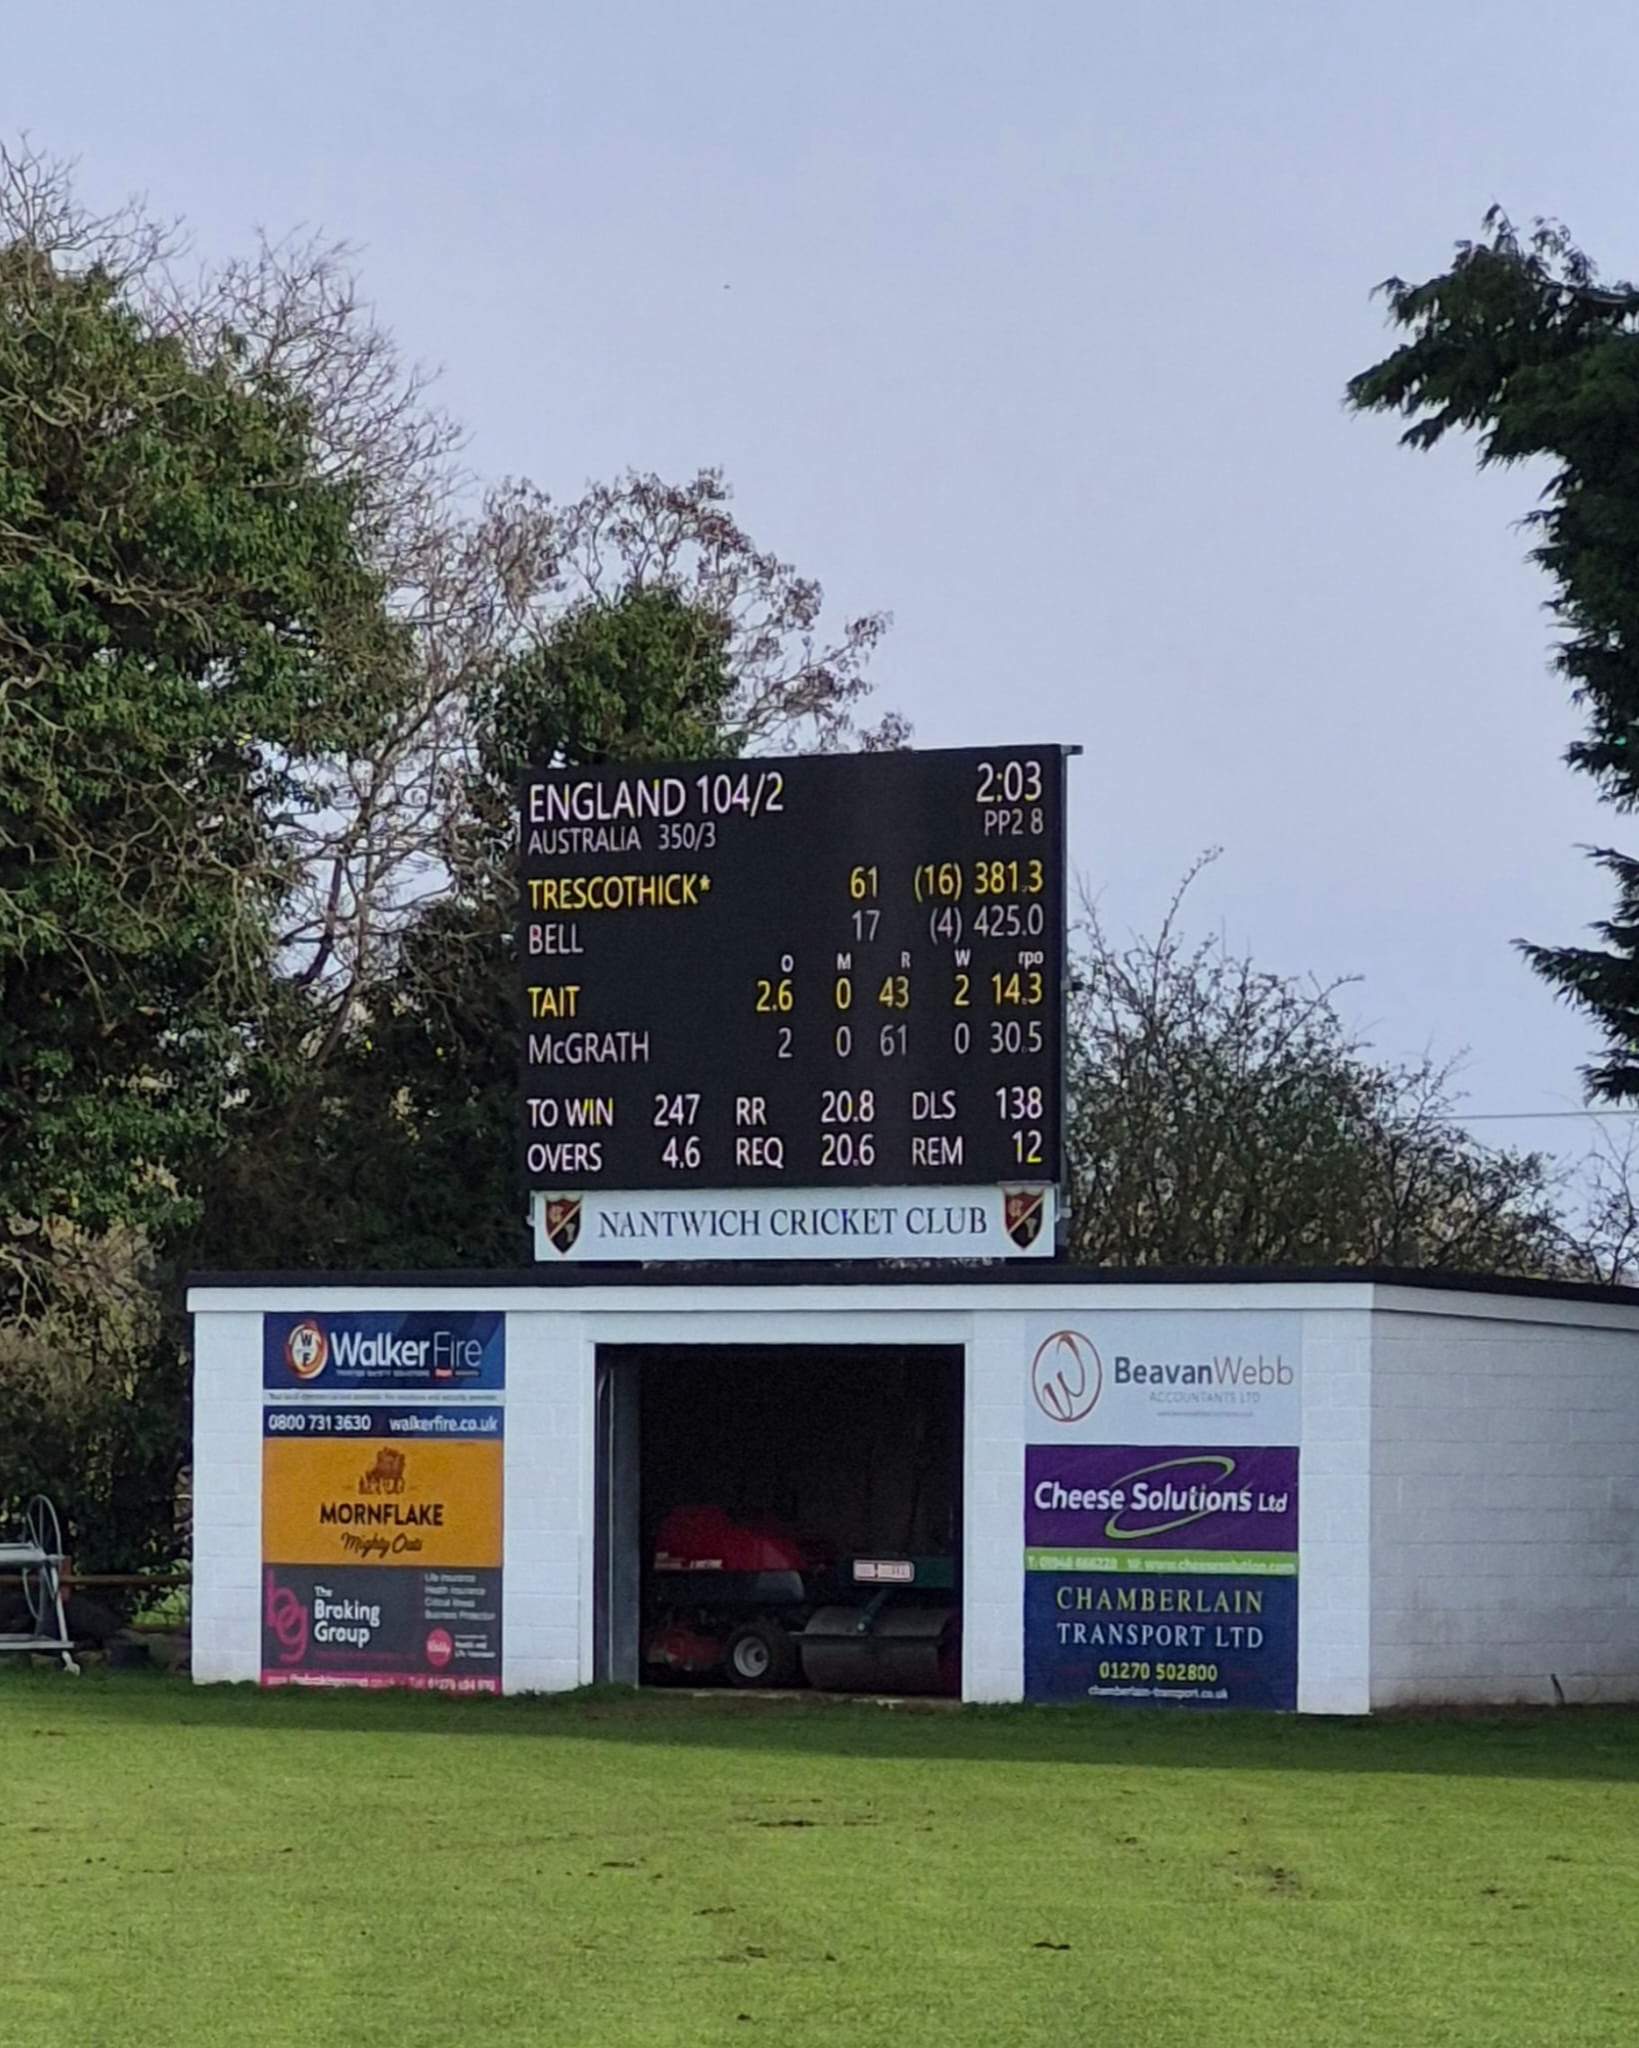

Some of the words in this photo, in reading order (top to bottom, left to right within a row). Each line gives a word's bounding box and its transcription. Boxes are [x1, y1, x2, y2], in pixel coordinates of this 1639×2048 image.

[976, 761, 1042, 803] 2:03
[530, 778, 686, 823] ENGLAND
[696, 771, 784, 817] 104/2
[984, 808, 1024, 836] PP2
[1030, 808, 1044, 835] 8
[528, 825, 642, 855] AUSTRALIA
[658, 821, 717, 851] 350/3
[850, 866, 878, 899] 61
[914, 863, 963, 903] (16)
[974, 859, 1044, 896] 381.3
[528, 923, 584, 954] BELL
[852, 910, 881, 941] 17
[930, 906, 963, 944] (4)
[973, 903, 1044, 937] 425.0
[836, 952, 852, 971] M
[901, 951, 911, 969] R
[954, 948, 971, 967] W
[1018, 951, 1044, 970] rpo
[527, 985, 581, 1018] TAIT
[755, 978, 793, 1012] 2.6
[836, 977, 851, 1010] 0
[878, 975, 910, 1008] 43
[953, 974, 971, 1007] 2
[991, 971, 1043, 1006] 14.3
[528, 1030, 649, 1065] McGRATH
[778, 1026, 793, 1059] 2
[836, 1025, 851, 1058] 0
[879, 1024, 907, 1056] 61
[953, 1021, 971, 1055] 0
[989, 1020, 1043, 1054] 30.5
[526, 1098, 558, 1128] TO
[564, 1096, 613, 1127] WIN
[653, 1093, 701, 1127] 247
[736, 1096, 767, 1126] RR
[820, 1089, 875, 1123] 20.8
[912, 1089, 956, 1120] DLS
[995, 1086, 1043, 1120] 138
[527, 1142, 602, 1172] OVERS
[661, 1136, 701, 1169] 4.6
[736, 1136, 784, 1169] REQ
[820, 1133, 875, 1167] 20.6
[912, 1136, 963, 1166] REM
[1012, 1129, 1042, 1163] 12
[598, 1209, 760, 1238] NANTWICH
[769, 1207, 898, 1237] CRICKET
[905, 1206, 987, 1235] CLUB
[268, 1413, 305, 1431] 0800
[308, 1414, 332, 1431] 731
[334, 1414, 371, 1431] 3630
[389, 1415, 498, 1432] walkerfire.co.uk
[1034, 1481, 1126, 1511] Cheese
[1131, 1482, 1252, 1512] Solutions
[1258, 1493, 1289, 1513] Ltd
[319, 1503, 444, 1526] MORNFLAKE
[340, 1531, 391, 1559] Mighty
[391, 1532, 423, 1554] Oats
[314, 1586, 333, 1598] The
[1057, 1586, 1263, 1614] CHAMBERLAIN
[314, 1599, 381, 1627] Broking
[314, 1621, 371, 1648] Group
[1057, 1622, 1205, 1647] TRANSPORT
[1216, 1626, 1264, 1649] LTD
[1099, 1661, 1150, 1681] 01270
[1155, 1663, 1218, 1682] 502800
